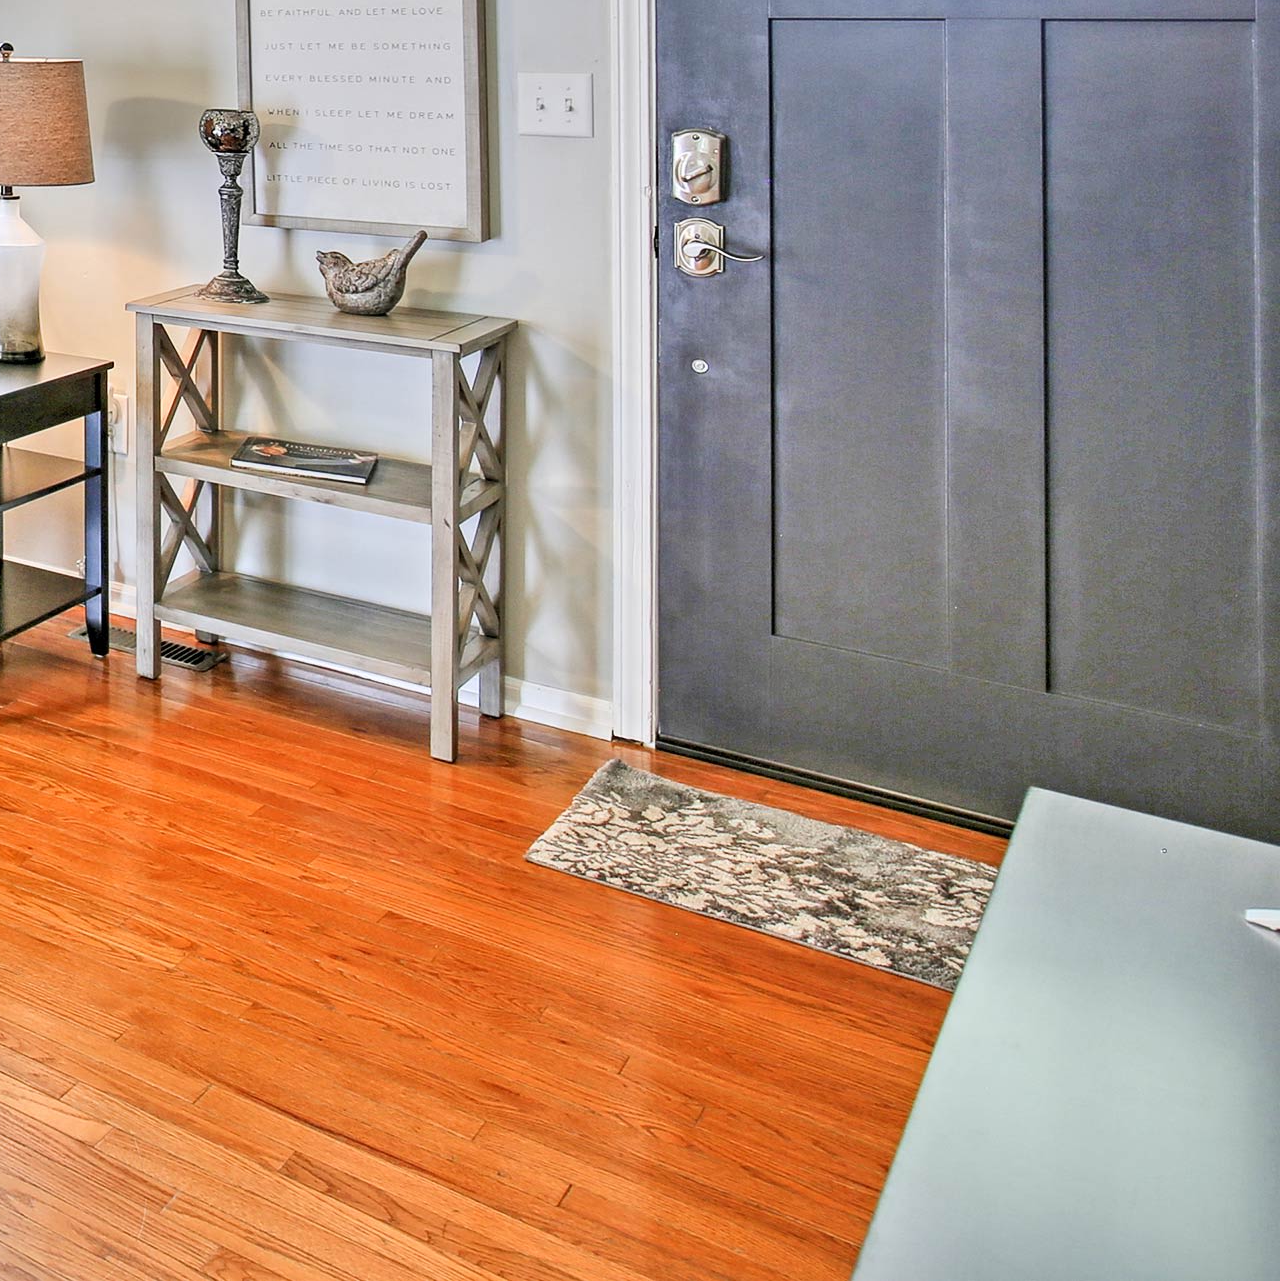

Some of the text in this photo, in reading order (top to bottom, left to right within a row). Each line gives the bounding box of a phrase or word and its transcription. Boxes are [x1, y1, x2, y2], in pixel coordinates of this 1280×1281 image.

[260, 9, 273, 17] BE
[338, 8, 362, 16] AND
[366, 7, 386, 16] LET
[391, 7, 407, 16] ME
[264, 42, 451, 51] JUST LET ME BE SOMETHING
[265, 74, 452, 85] EVERY BLESSED MINUTE AND
[266, 108, 300, 117] WHEN
[314, 109, 352, 118] SLEEP
[357, 110, 380, 118] LET
[386, 111, 404, 119] ME
[409, 111, 455, 120] DREAM
[269, 141, 456, 157] ALL THE TIME SO THAT NOT ONE
[266, 174, 303, 183] LITTLE
[307, 175, 338, 185] PIECE
[342, 177, 358, 185] OF
[361, 178, 401, 189] LIVING
[405, 180, 416, 189] IS
